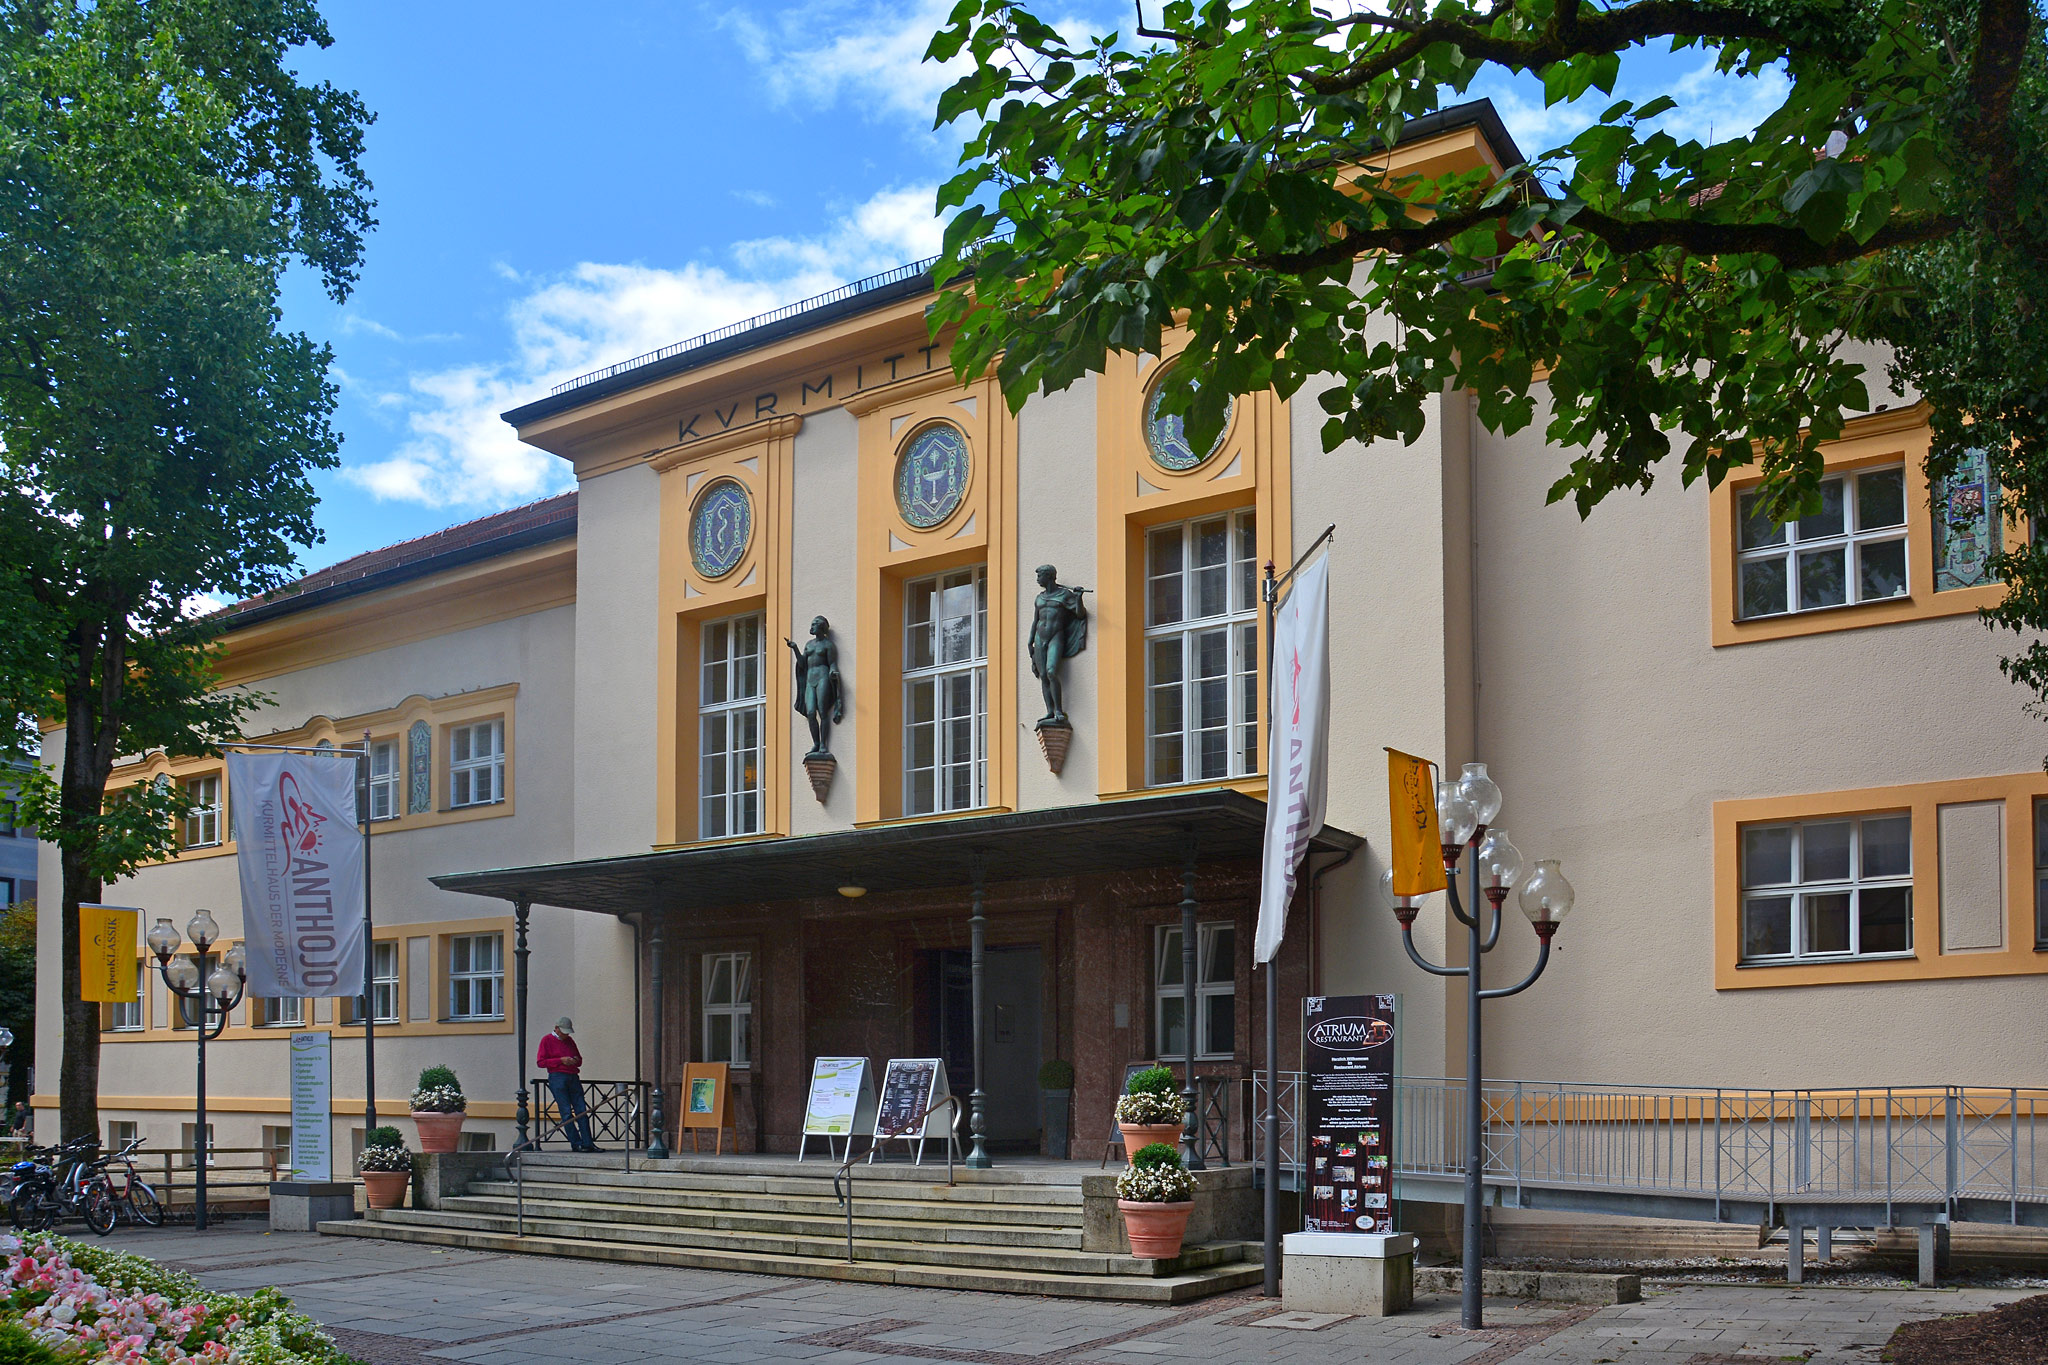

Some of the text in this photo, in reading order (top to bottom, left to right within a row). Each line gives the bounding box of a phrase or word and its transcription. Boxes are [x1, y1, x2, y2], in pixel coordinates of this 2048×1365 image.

[678, 343, 940, 442] KVRMITT
[1282, 738, 1311, 916] ANTHO
[262, 799, 289, 986] KURMITTELHAUS DER MODERNE
[292, 857, 338, 987] ANTHOJO
[107, 917, 118, 995] AlpenKLASSIK
[1314, 1023, 1366, 1037] ATRIUM
[1316, 1035, 1364, 1043] RESTAURANT
